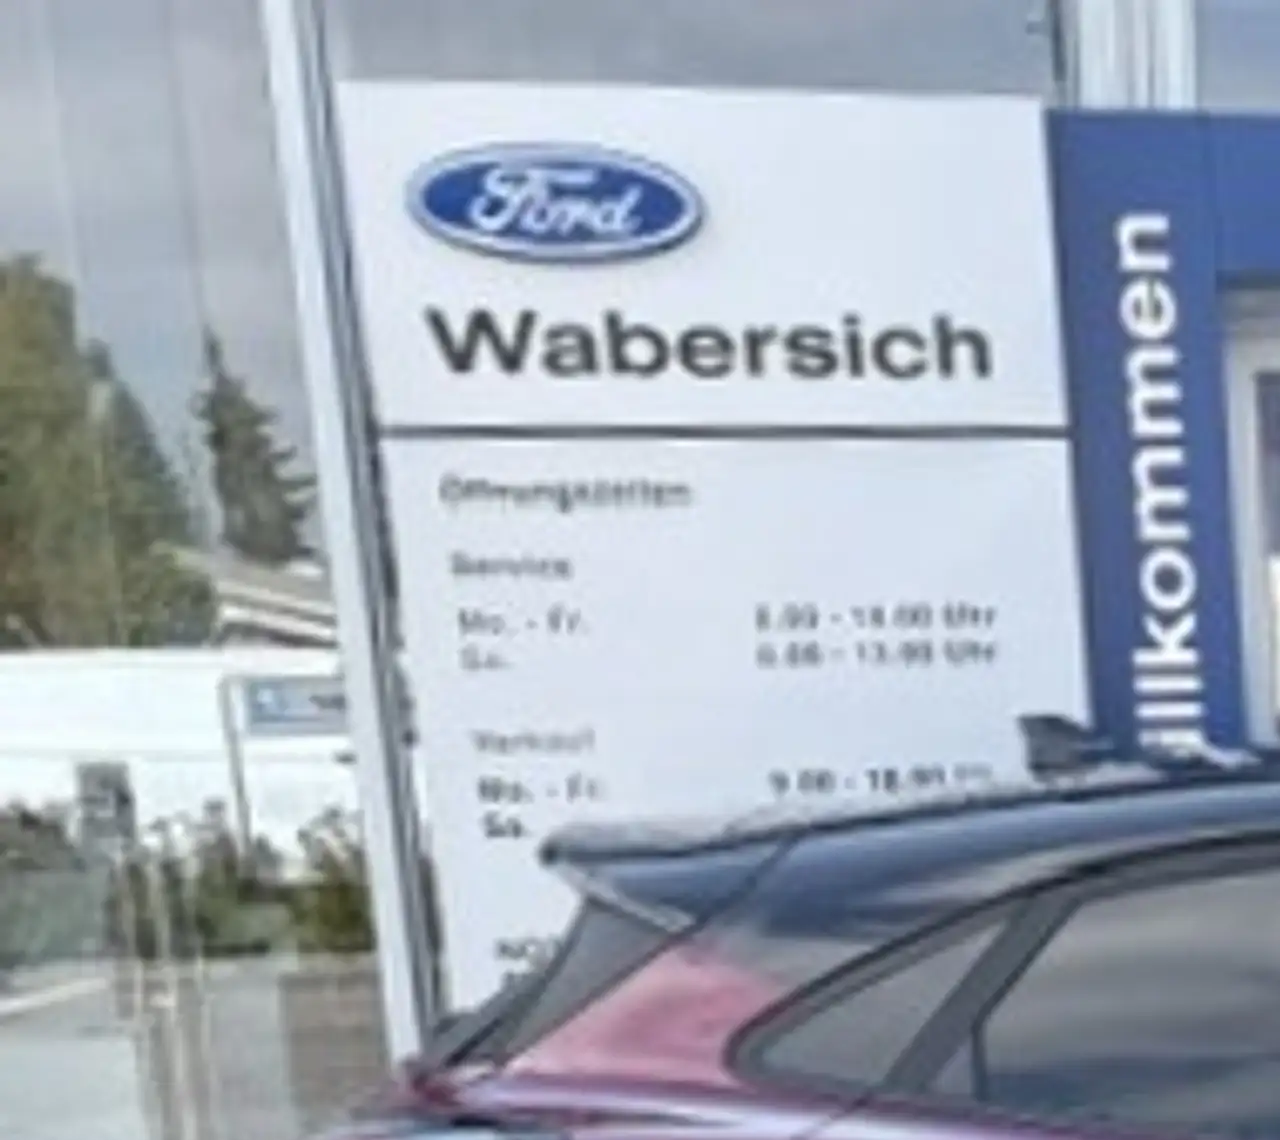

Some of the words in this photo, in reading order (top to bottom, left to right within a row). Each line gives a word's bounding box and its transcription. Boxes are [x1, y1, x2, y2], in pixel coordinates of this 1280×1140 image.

[468, 167, 644, 236] Ford
[424, 304, 994, 379] Wabersich
[1115, 211, 1204, 758] illkommen
